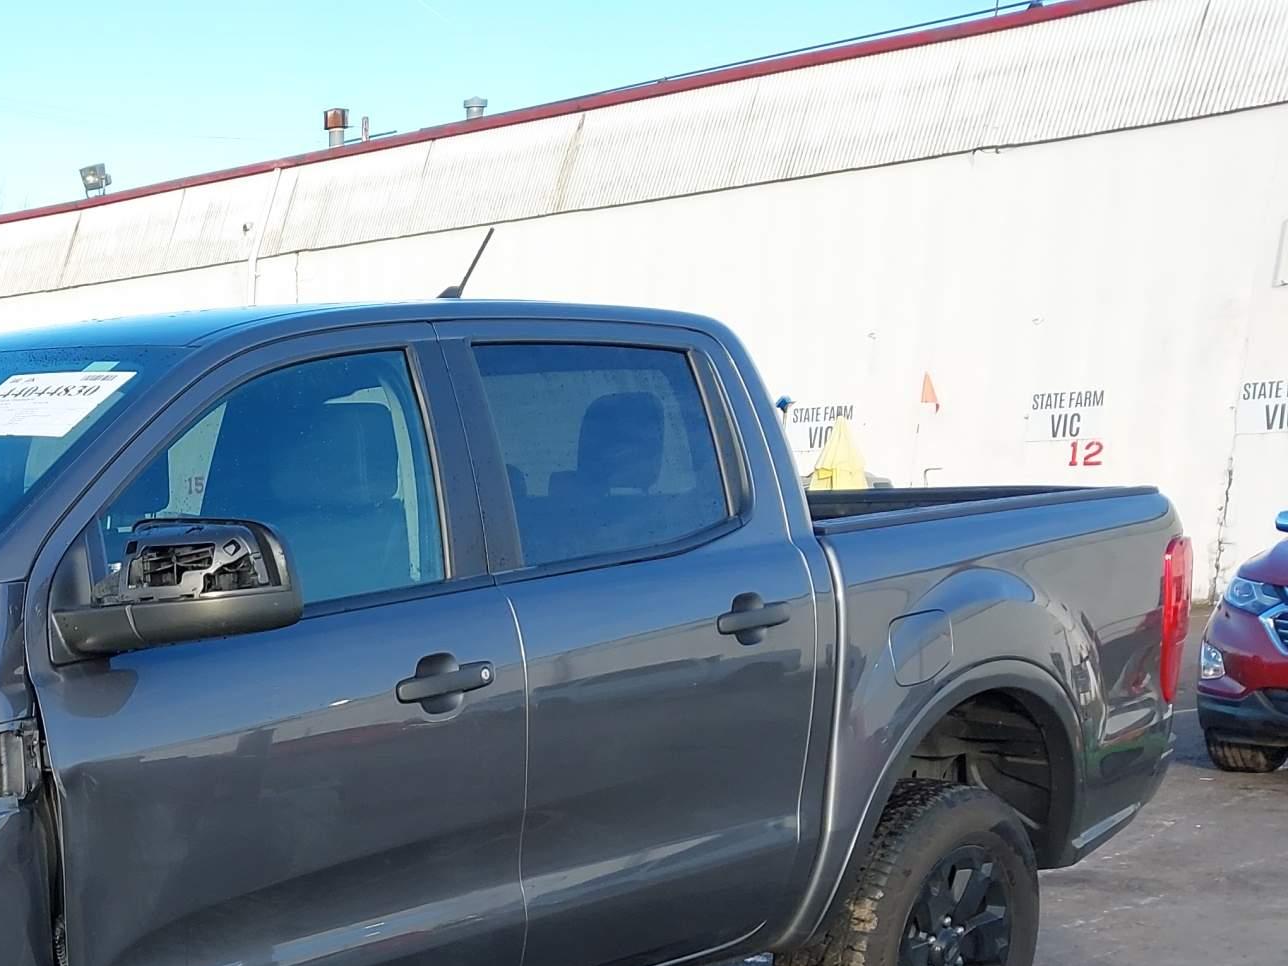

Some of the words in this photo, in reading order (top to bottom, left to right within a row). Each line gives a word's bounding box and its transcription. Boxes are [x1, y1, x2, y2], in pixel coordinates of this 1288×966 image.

[0, 385, 102, 399] 44044830
[1032, 391, 1067, 410] STATE
[1068, 389, 1105, 408] FARM
[1242, 380, 1285, 401] STATE
[792, 407, 822, 424] STATE
[823, 404, 854, 422] FARM
[1265, 403, 1288, 430] VI
[1051, 412, 1081, 438] VIC
[1068, 440, 1104, 466] 12
[187, 476, 205, 495] 15
